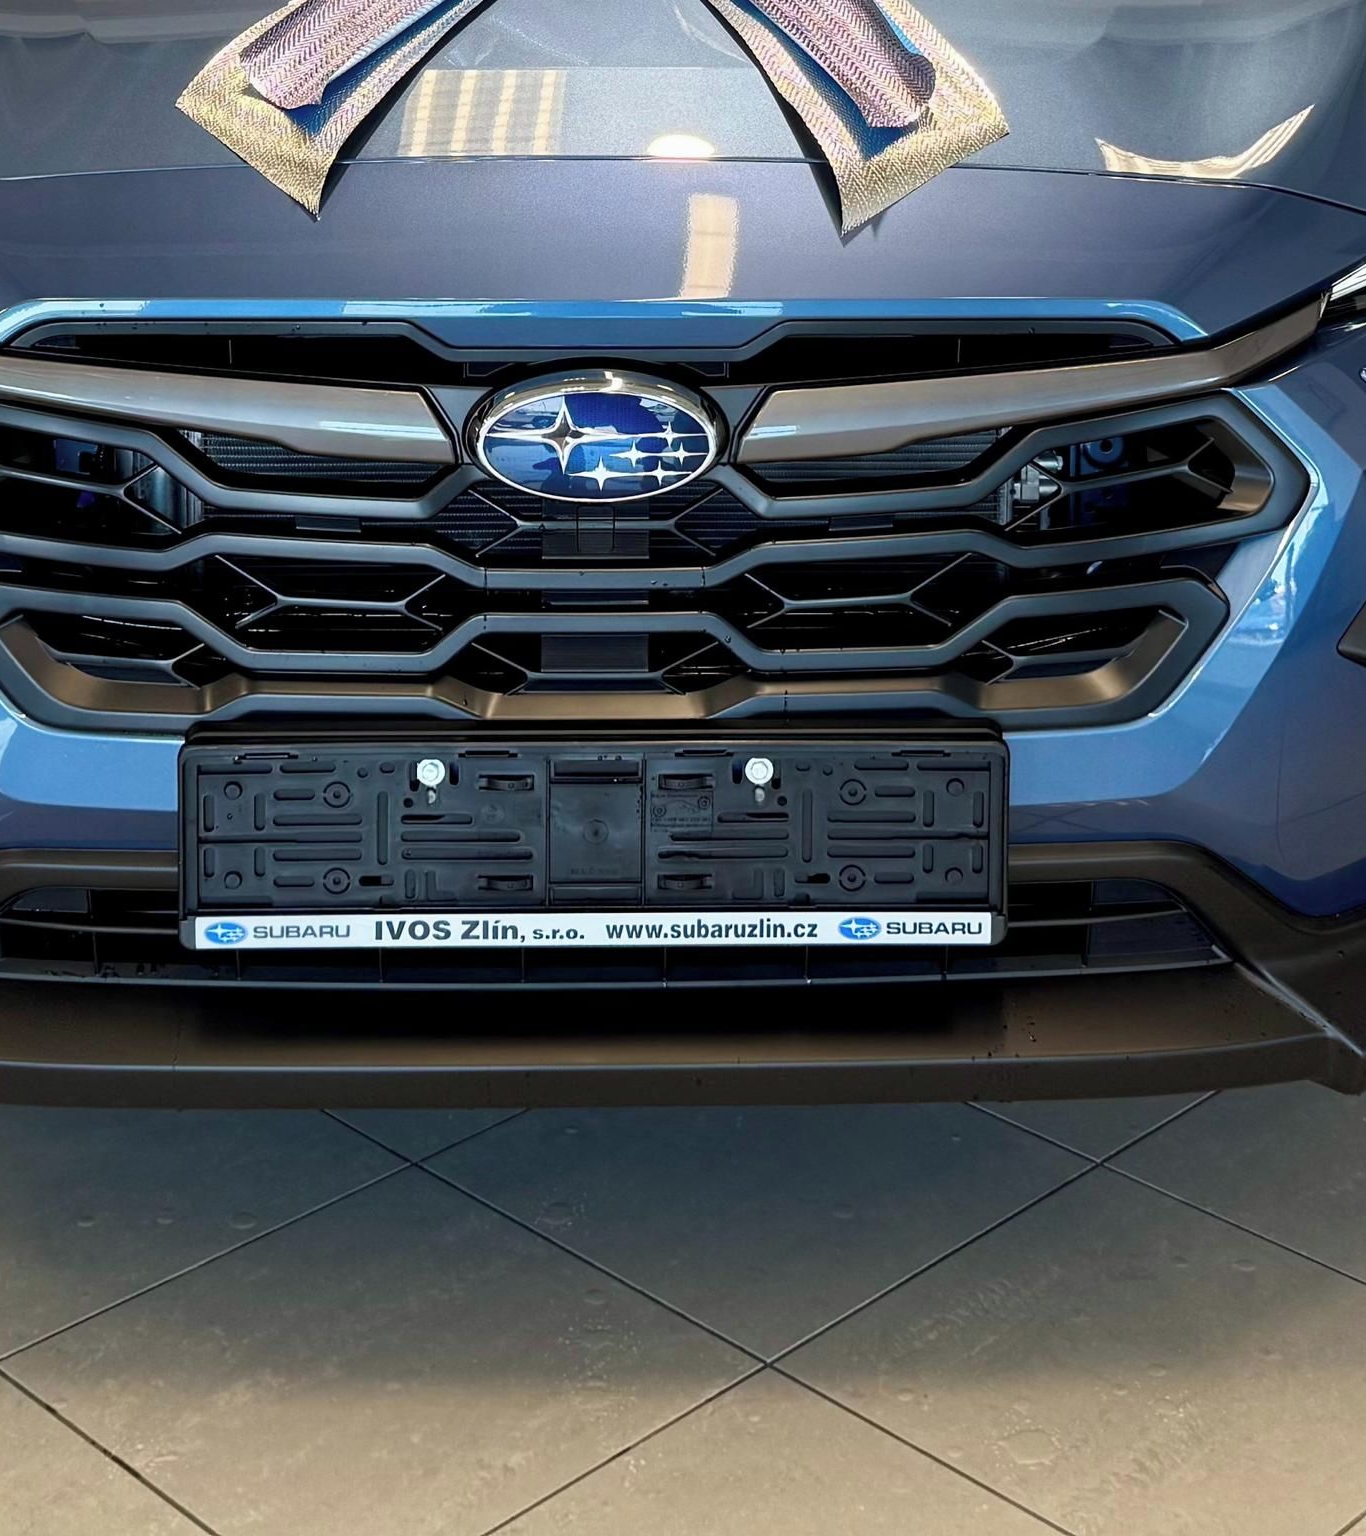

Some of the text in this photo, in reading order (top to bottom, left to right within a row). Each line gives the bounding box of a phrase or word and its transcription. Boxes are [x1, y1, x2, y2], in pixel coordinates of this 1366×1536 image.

[252, 917, 984, 944] SUBARU IVOS Zlín, s.r.o. www.subaruzlin.cz SUBARU
